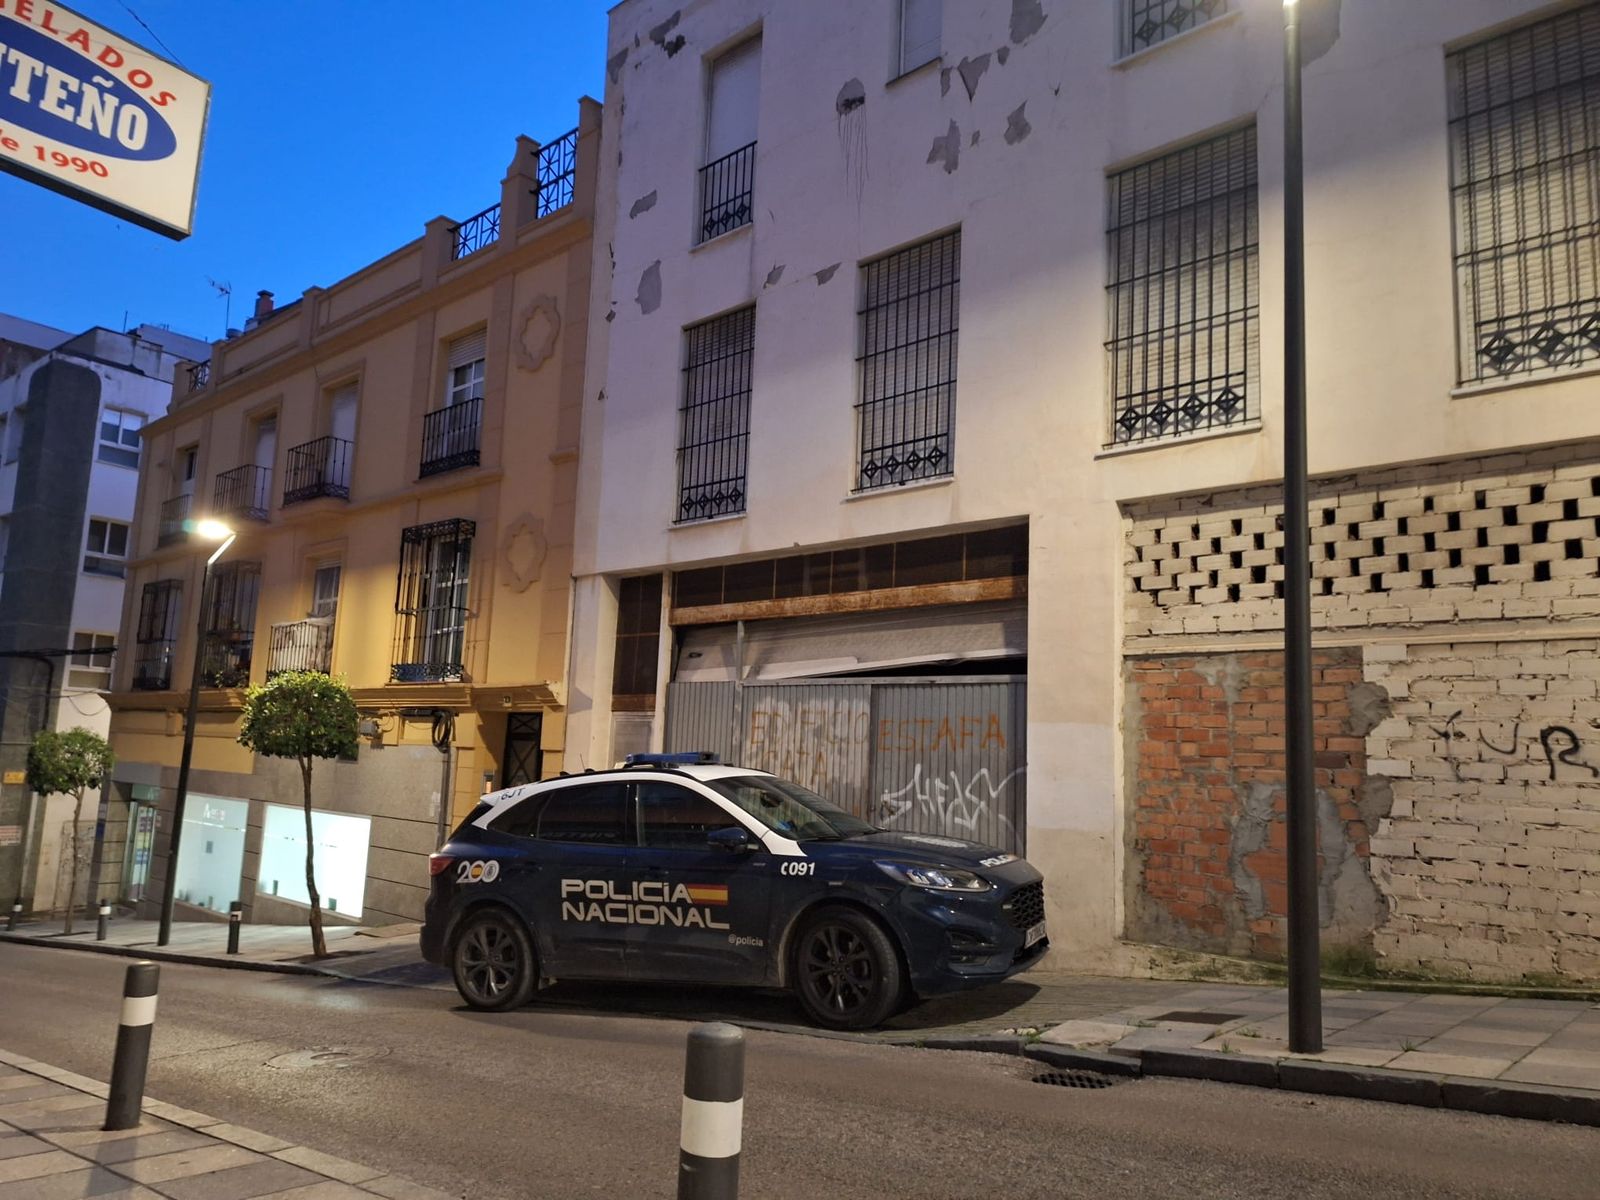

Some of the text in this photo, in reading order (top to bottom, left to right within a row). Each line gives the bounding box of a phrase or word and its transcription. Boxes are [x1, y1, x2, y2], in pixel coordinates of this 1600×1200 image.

[0, 0, 177, 107] ELADOS
[0, 42, 149, 151] TEÑO
[34, 145, 108, 178] 1990
[877, 712, 1007, 752] ESTAFA
[455, 860, 500, 884] 200
[562, 901, 730, 930] NACIONAL
